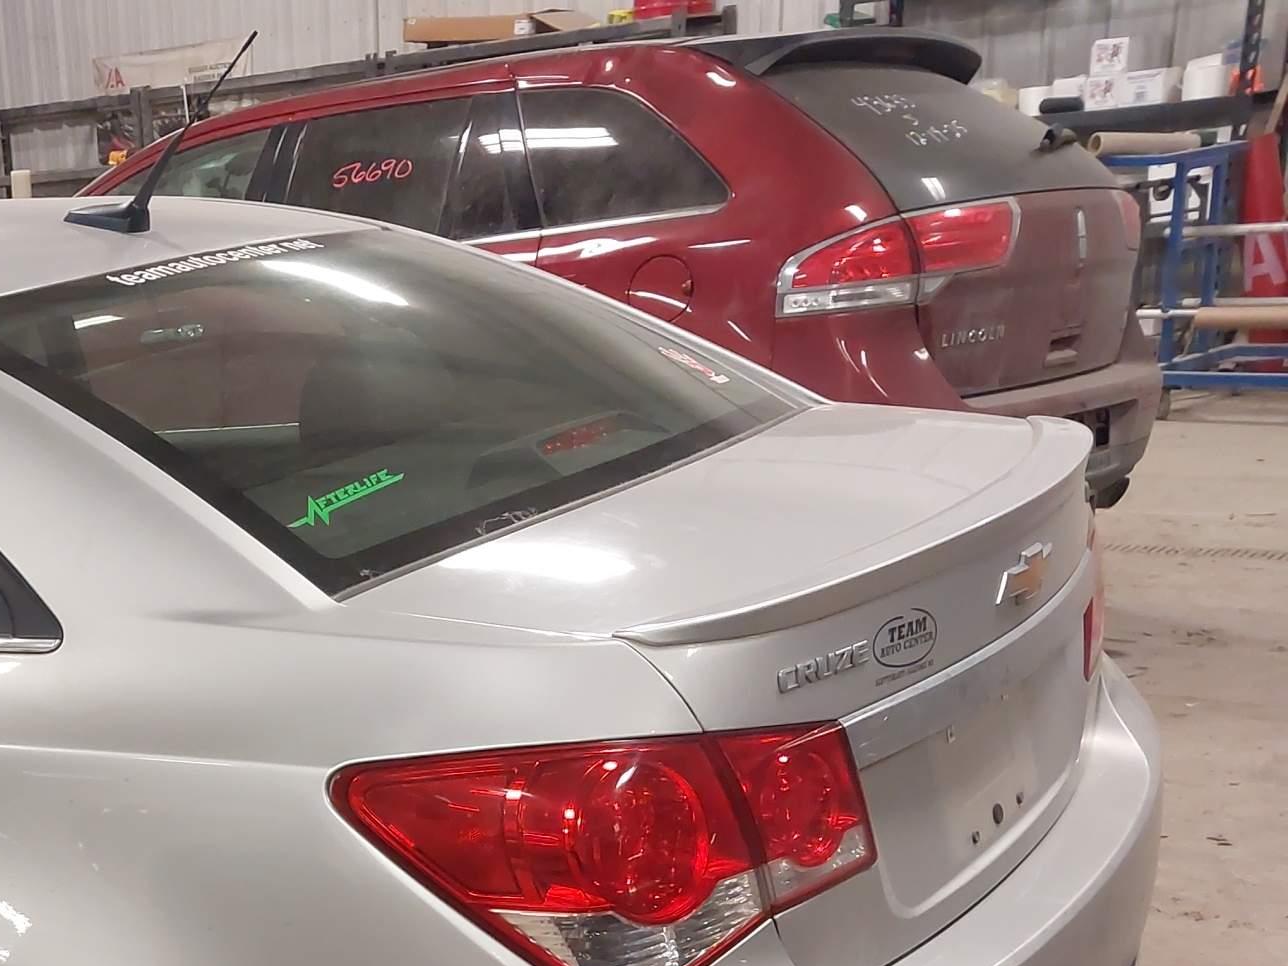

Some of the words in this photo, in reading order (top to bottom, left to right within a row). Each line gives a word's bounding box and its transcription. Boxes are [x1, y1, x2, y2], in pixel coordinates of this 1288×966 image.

[332, 158, 413, 188] 56690
[941, 324, 1006, 348] LINCOLN
[288, 468, 403, 527] AFTERLIFE
[887, 615, 928, 644] TEAM
[879, 642, 903, 659] AUTO
[902, 630, 936, 651] CENTER
[777, 639, 870, 694] CRUZE
